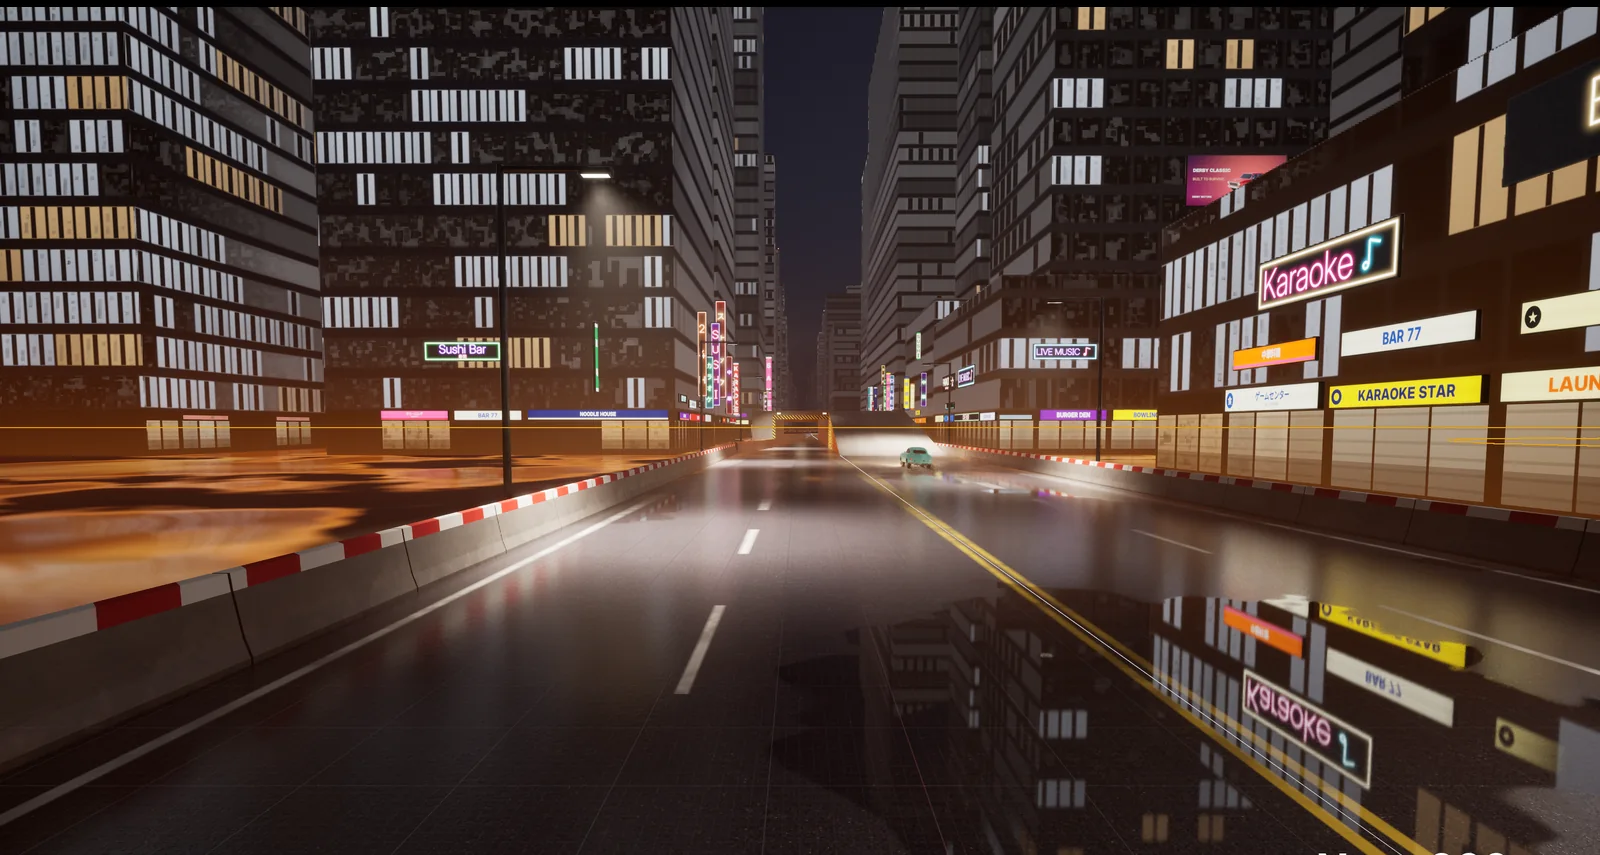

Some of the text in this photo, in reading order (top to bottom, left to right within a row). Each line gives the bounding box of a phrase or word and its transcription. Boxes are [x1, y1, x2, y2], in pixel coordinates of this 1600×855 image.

[1263, 249, 1354, 301] Karaoke
[1382, 326, 1422, 345] BAR 77
[438, 344, 487, 355] Sushi Bar
[1036, 348, 1081, 356] LIVE MUSIC
[1358, 384, 1456, 401] KARAOKE STAR
[1548, 375, 1600, 393] LAUN
[1255, 390, 1290, 401] ゲームセンター
